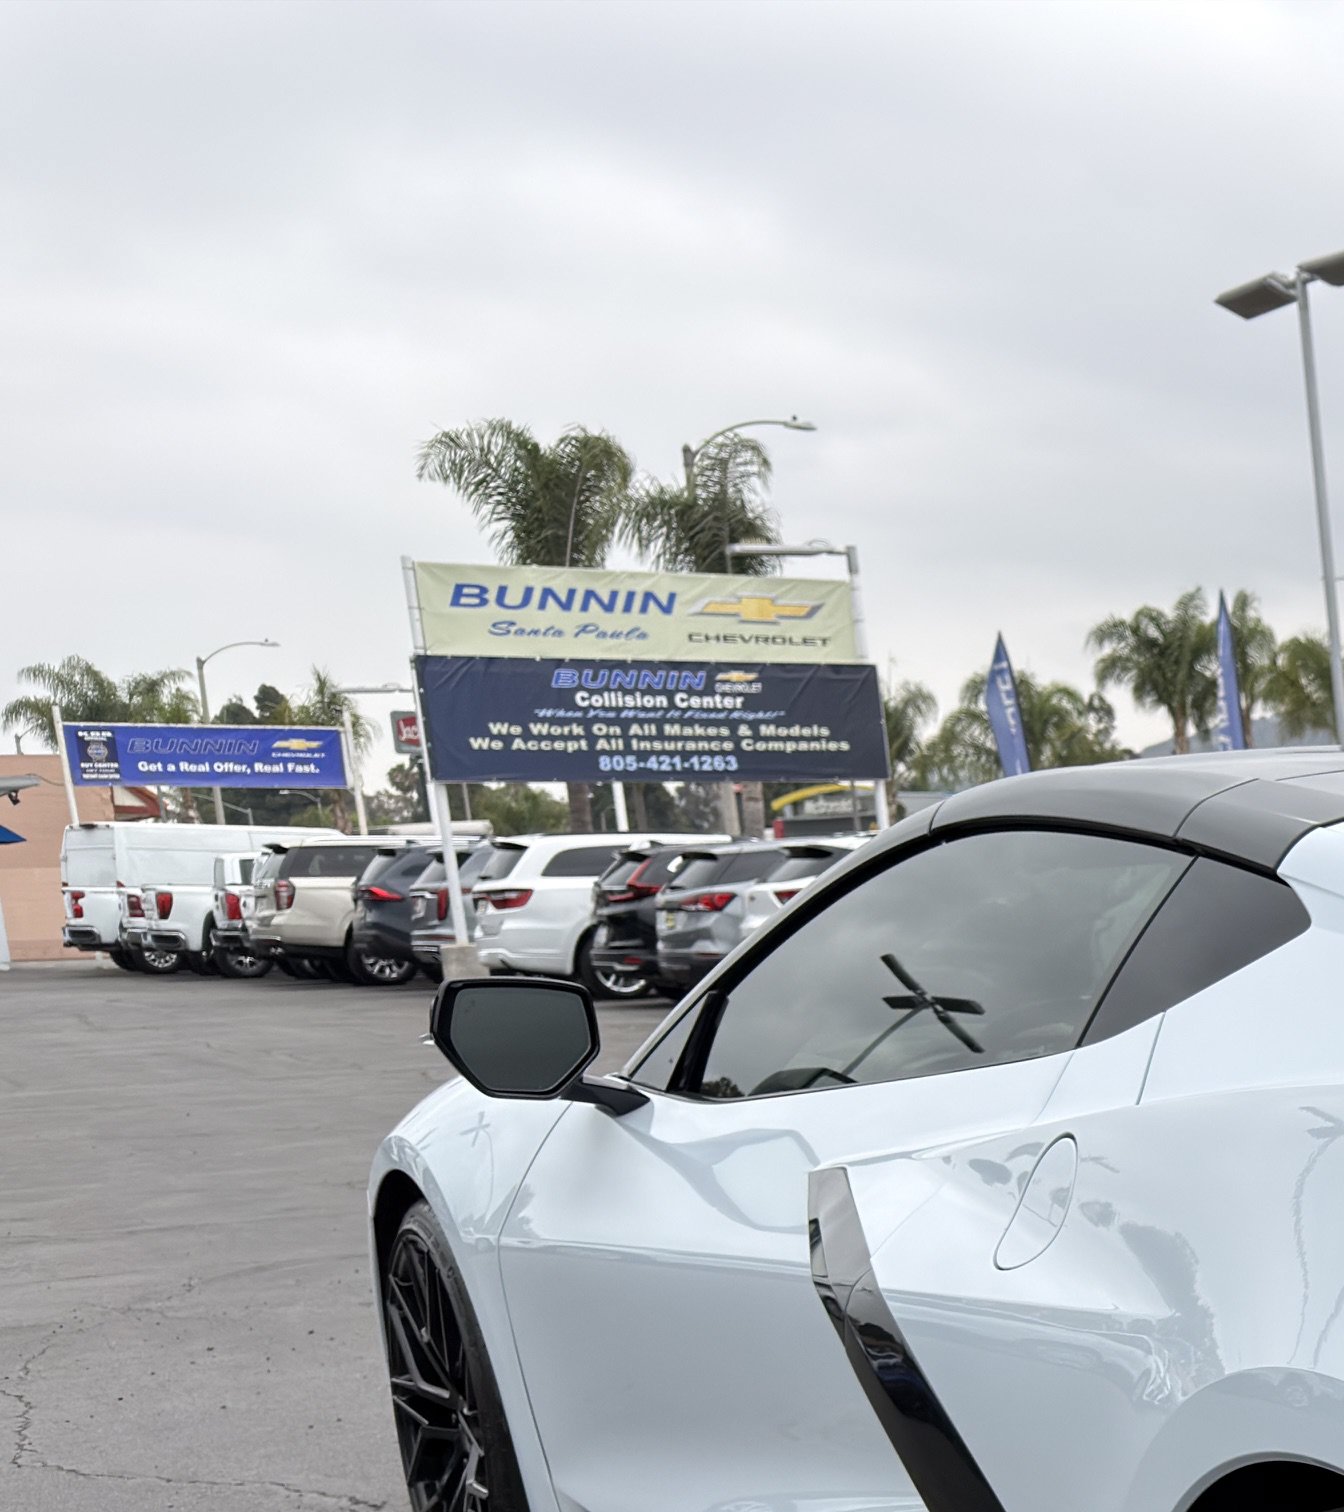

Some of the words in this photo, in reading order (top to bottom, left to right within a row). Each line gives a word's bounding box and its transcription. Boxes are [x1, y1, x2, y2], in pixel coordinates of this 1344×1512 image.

[450, 583, 677, 616] BUNNIN
[488, 620, 565, 638] Santa
[574, 622, 650, 641] Paula
[687, 632, 832, 648] CHEVROLET
[551, 668, 707, 691] BUNNIN
[574, 690, 668, 708] Collision
[674, 692, 745, 709] Center
[488, 721, 523, 736] We
[529, 722, 585, 736] Work
[591, 722, 622, 736] On
[628, 723, 657, 737] All
[663, 723, 731, 737] Makes
[737, 723, 753, 737] &
[759, 724, 831, 738] Models
[127, 737, 260, 755] BUNNIN
[469, 736, 504, 751] We
[511, 737, 588, 753] Accept
[595, 738, 623, 751] All
[631, 738, 735, 752] Insurance
[740, 738, 850, 754] Companies
[137, 760, 163, 772] Get
[166, 763, 176, 773] a
[179, 761, 210, 773] Real
[213, 761, 251, 775] Offer,
[254, 762, 284, 774] Real
[287, 762, 320, 774] Fast.
[598, 754, 739, 772] 805-421-1263
